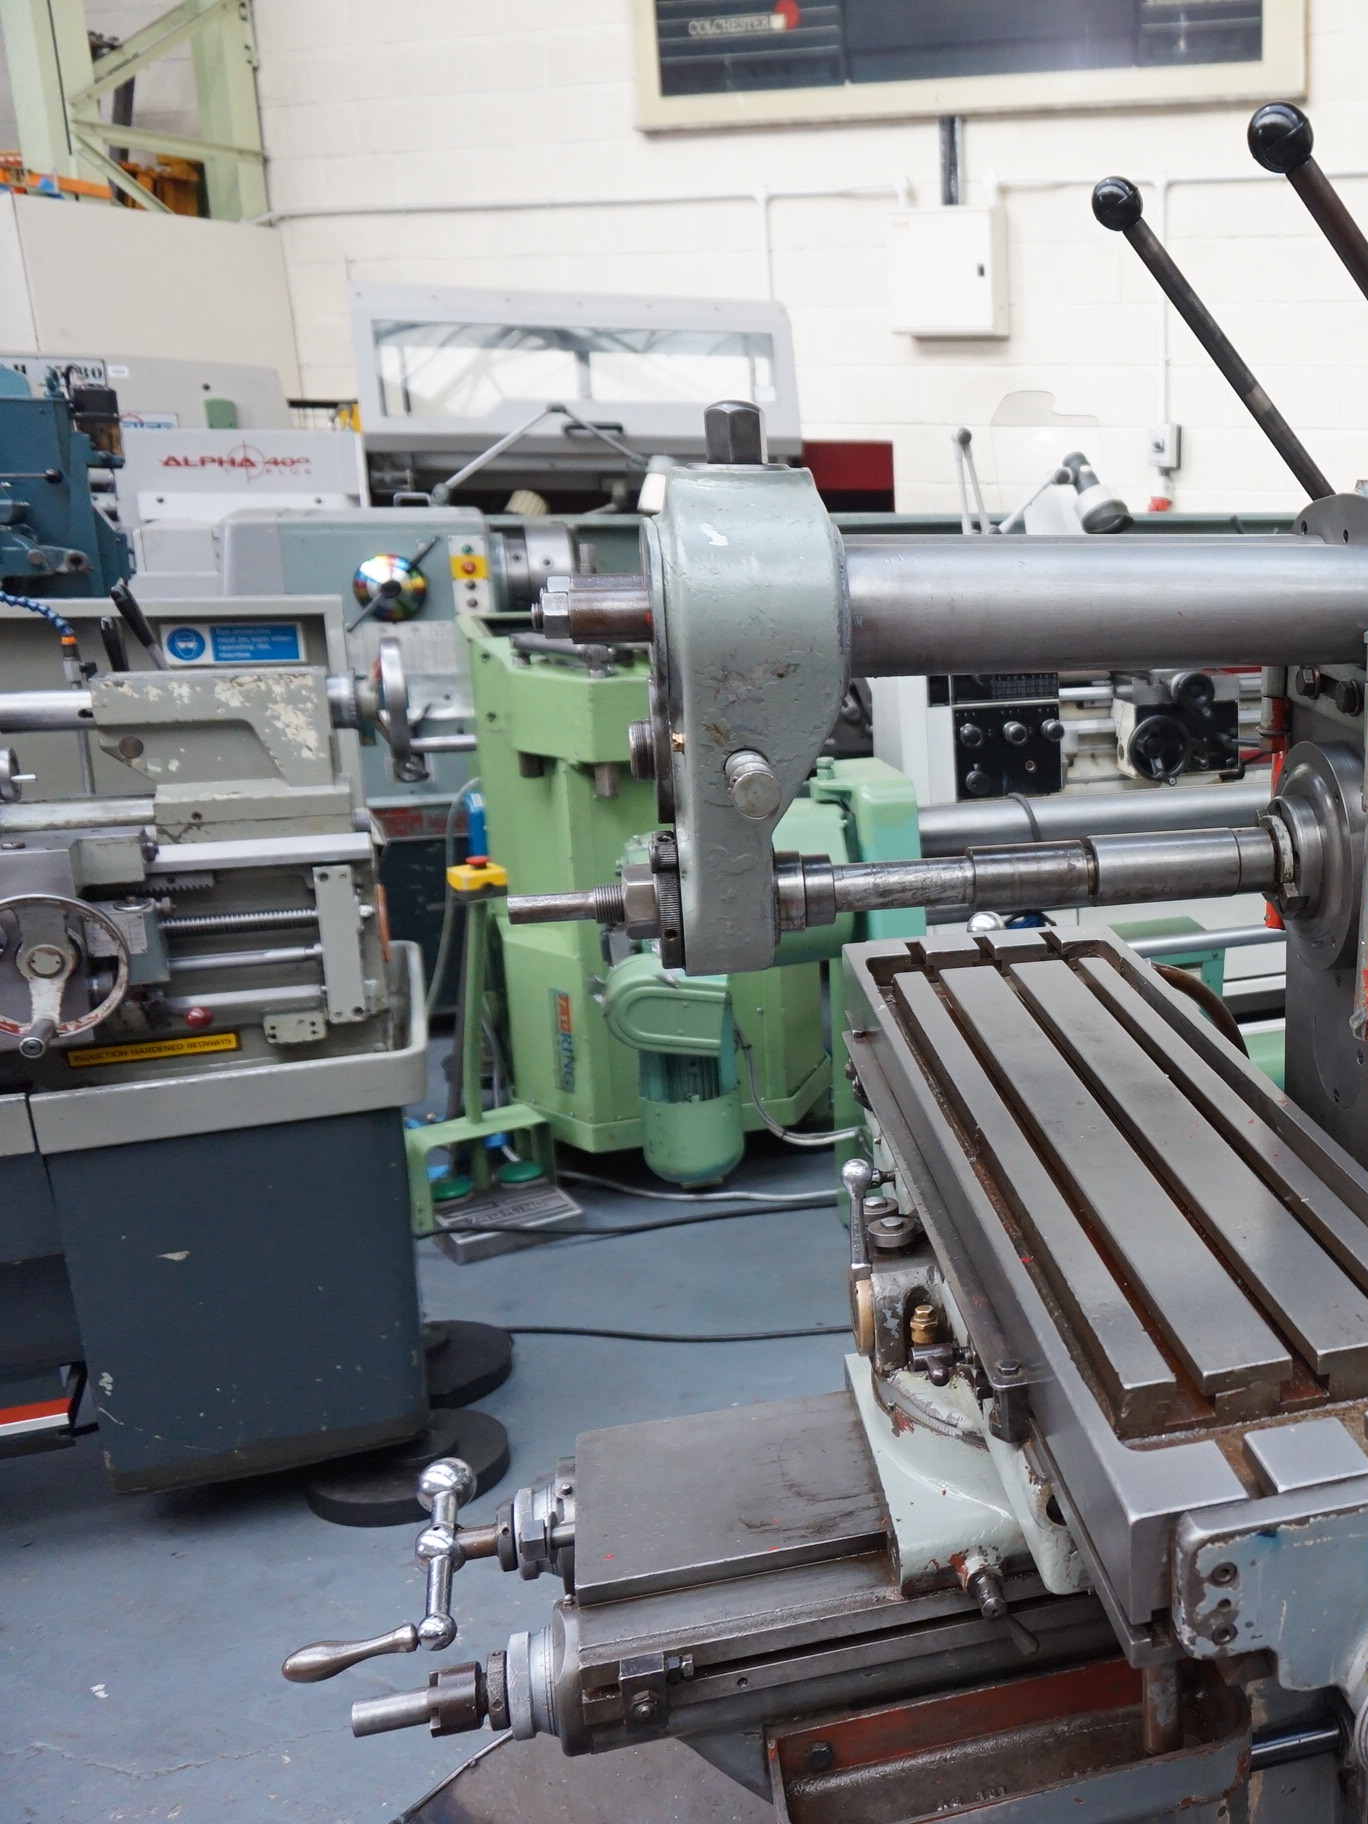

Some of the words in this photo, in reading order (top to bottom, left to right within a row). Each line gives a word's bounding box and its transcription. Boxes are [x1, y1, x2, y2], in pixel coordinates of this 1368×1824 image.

[688, 15, 770, 35] COLCHESTER
[162, 455, 256, 467] ALPHA
[73, 1049, 128, 1062] INDUCTION
[130, 1042, 184, 1056] HARDENED
[186, 1037, 232, 1050] BEDWAYS
